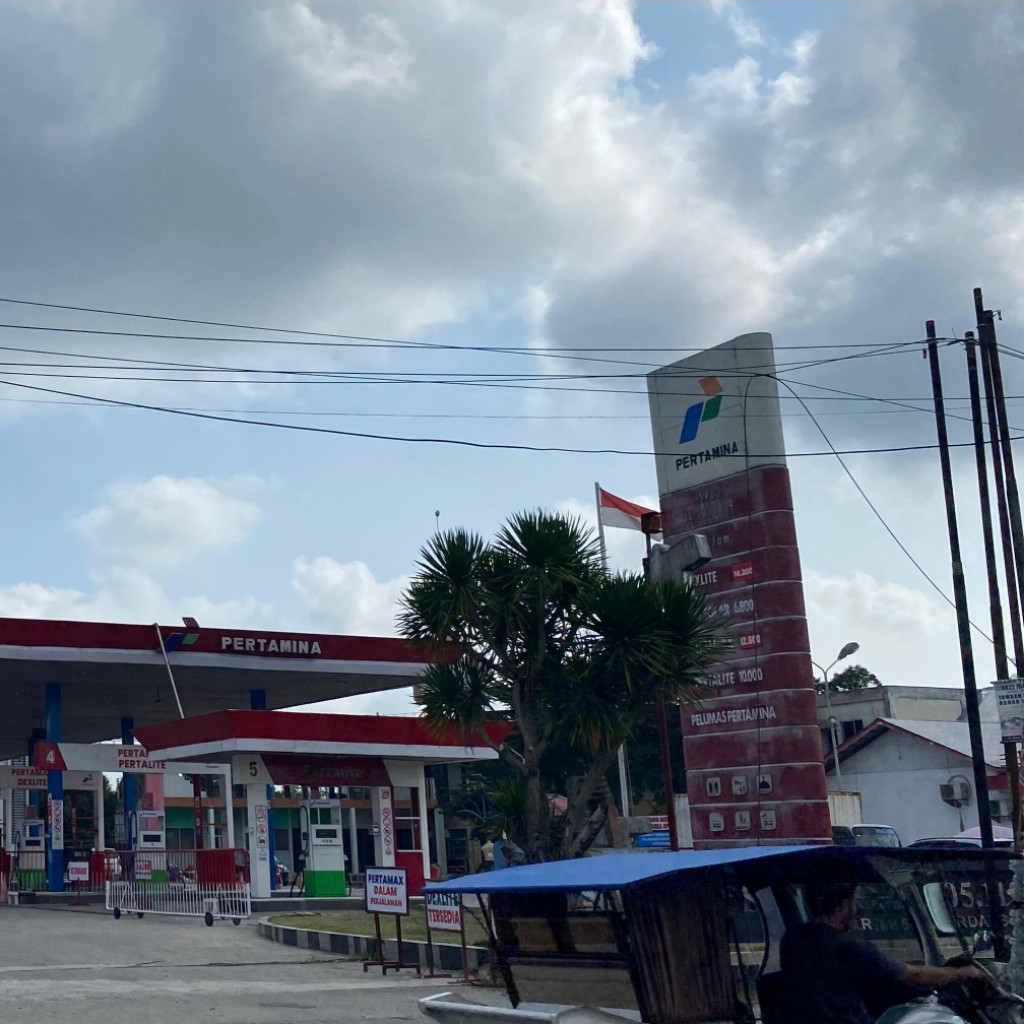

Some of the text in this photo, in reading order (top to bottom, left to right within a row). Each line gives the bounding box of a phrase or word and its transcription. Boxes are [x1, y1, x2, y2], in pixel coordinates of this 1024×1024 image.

[675, 440, 739, 472] PERTAMINA
[221, 636, 322, 655] PERTAMINA
[739, 667, 763, 684] 10.000
[691, 705, 776, 727] PELUMAS PERTAMINA
[46, 750, 56, 764] 4
[117, 748, 149, 758] PERTA
[118, 759, 167, 770] PERTALITE
[249, 761, 258, 777] 5
[367, 874, 404, 886] PERTAMAX
[374, 885, 397, 897] DALAM
[428, 908, 460, 925] TERSEDIA
